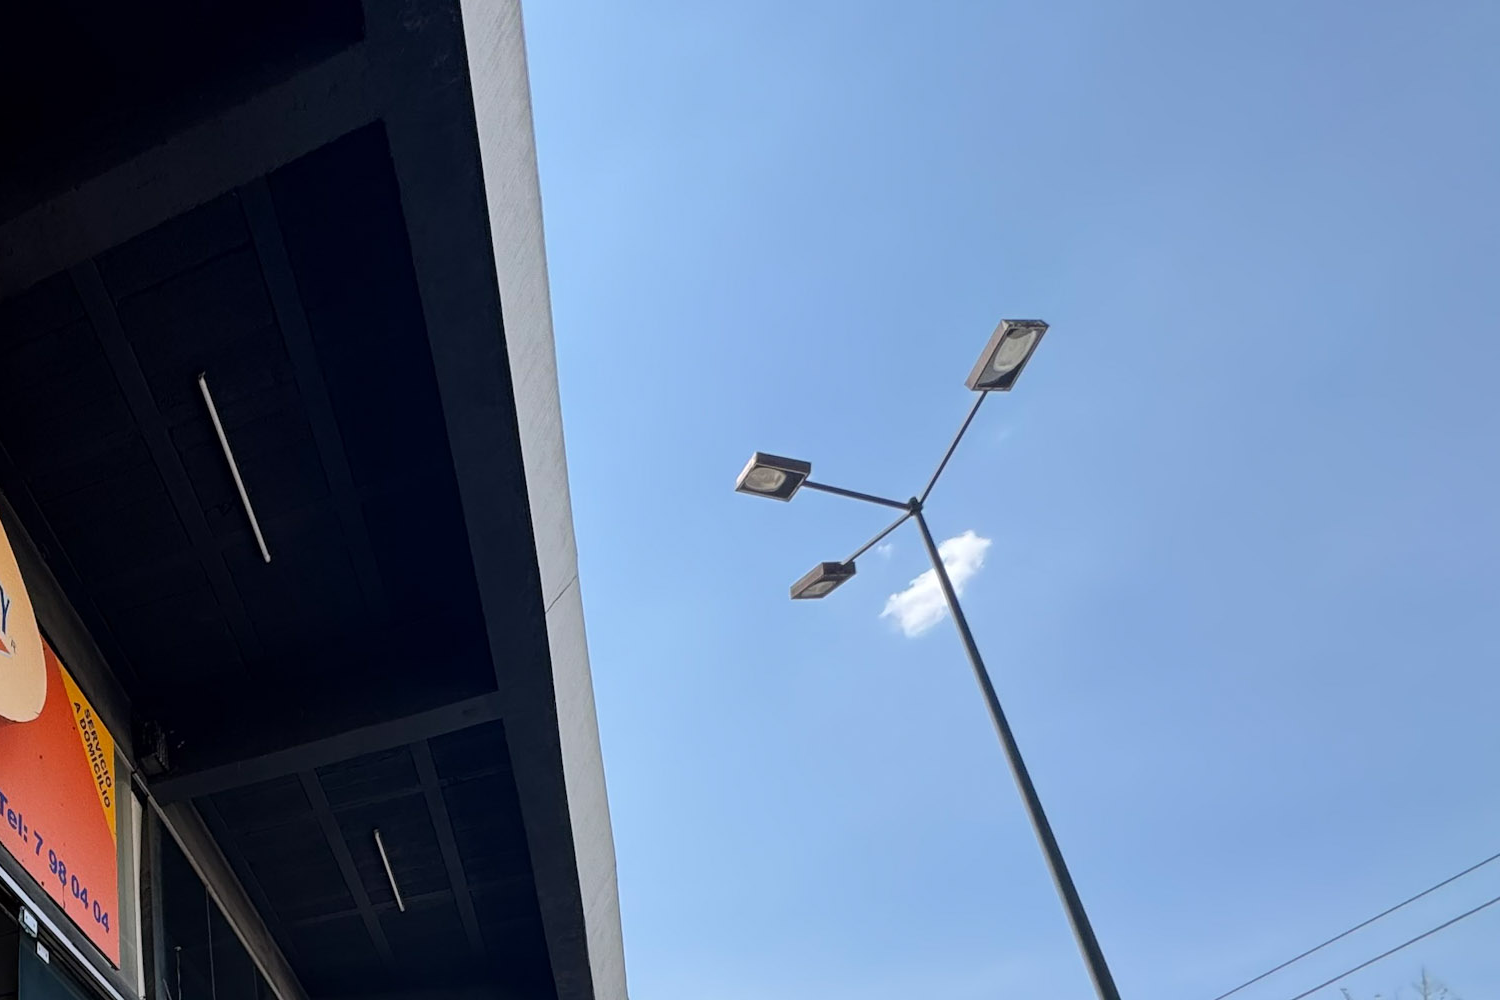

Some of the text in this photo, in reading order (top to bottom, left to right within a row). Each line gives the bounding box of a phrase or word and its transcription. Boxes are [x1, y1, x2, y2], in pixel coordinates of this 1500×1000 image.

[73, 701, 111, 808] A DOMICILIO
[84, 708, 112, 789] SERVICIO
[33, 830, 44, 856] 7
[48, 849, 67, 887] 98
[71, 874, 89, 910] 04
[93, 900, 110, 934] 04
